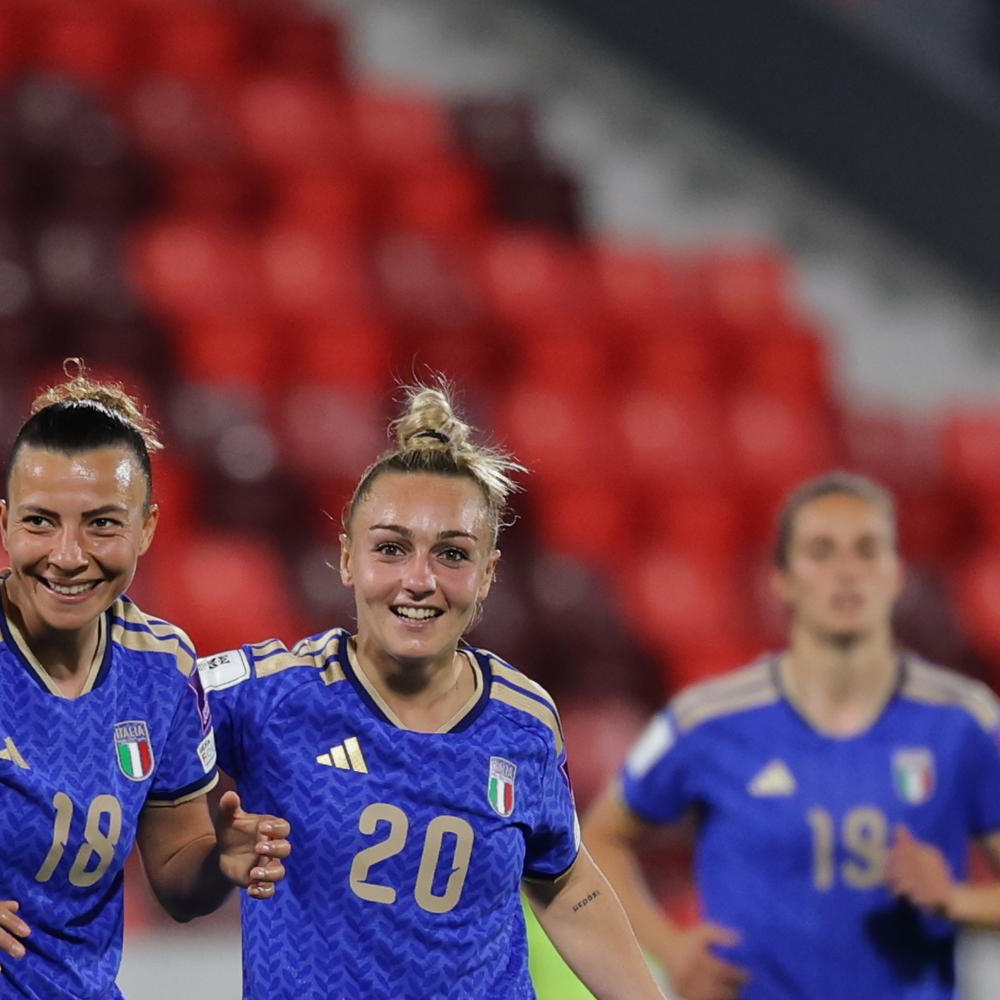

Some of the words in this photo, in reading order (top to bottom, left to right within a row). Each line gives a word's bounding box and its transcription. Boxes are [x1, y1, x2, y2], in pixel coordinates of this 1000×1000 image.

[35, 791, 122, 887] 18
[350, 803, 474, 913] 20
[807, 807, 887, 892] 19
